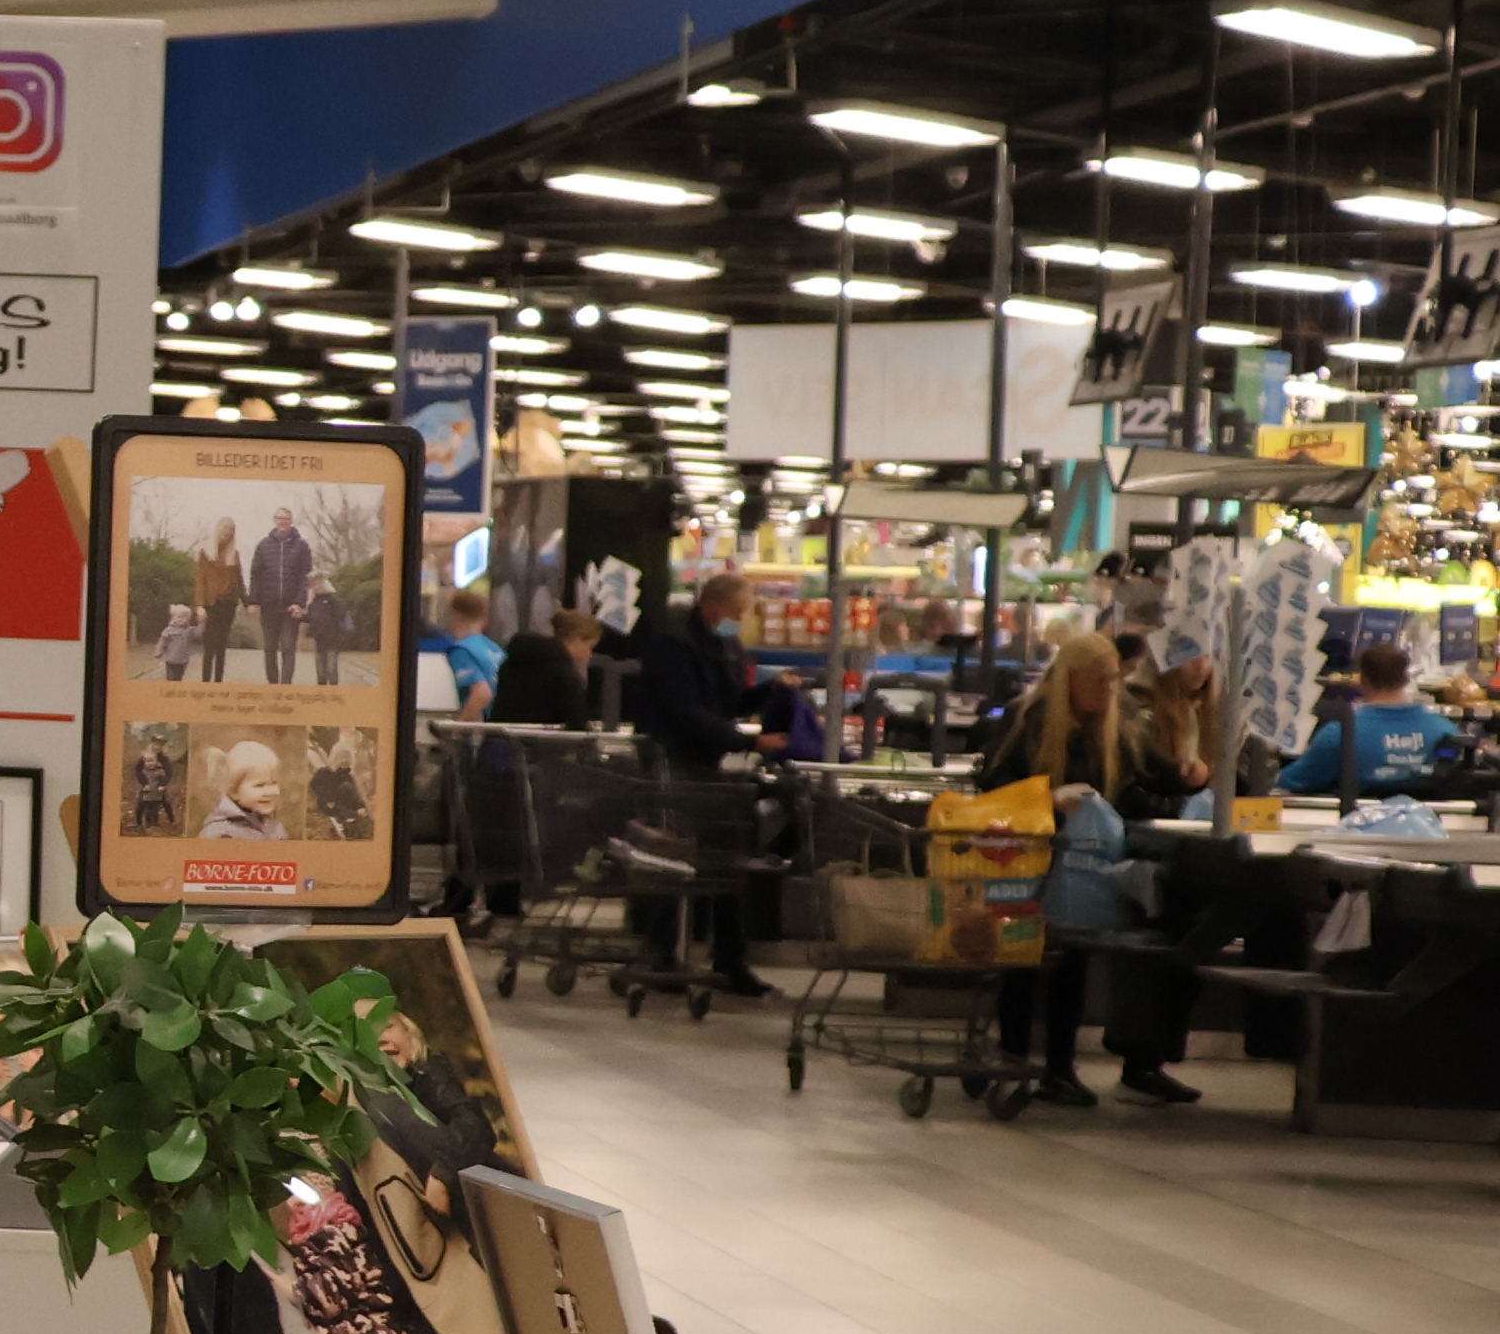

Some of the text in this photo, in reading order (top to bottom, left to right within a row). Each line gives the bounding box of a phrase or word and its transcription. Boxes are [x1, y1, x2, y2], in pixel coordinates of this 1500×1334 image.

[1121, 398, 1173, 434] 22
[196, 452, 260, 468] BILLEDER
[271, 454, 297, 470] DET
[301, 456, 323, 471] FRI
